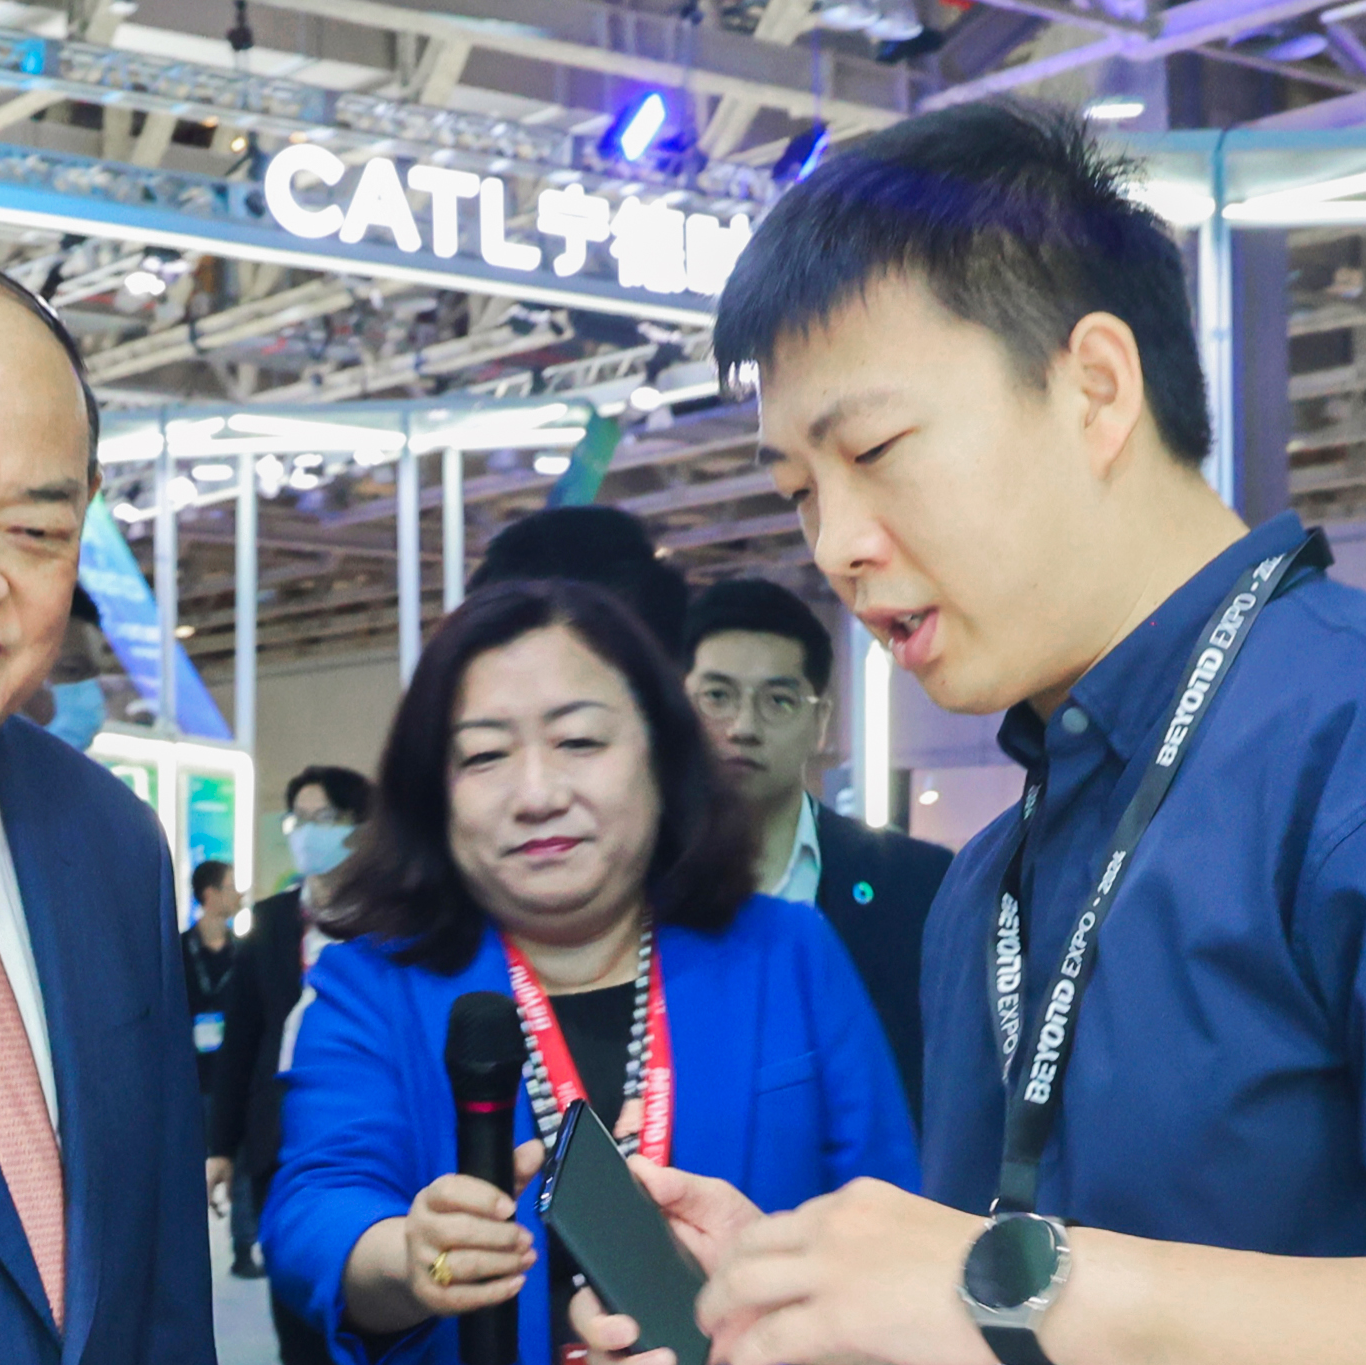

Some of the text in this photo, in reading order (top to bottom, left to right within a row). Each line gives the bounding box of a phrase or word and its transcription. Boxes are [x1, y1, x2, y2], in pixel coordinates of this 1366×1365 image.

[264, 143, 541, 272] CATL
[1155, 647, 1224, 767] BEYOND
[1209, 593, 1257, 650] EXPO
[997, 993, 1020, 1055] EXPO
[1024, 978, 1076, 1104] BEYOND
[1060, 911, 1096, 979] EXPO
